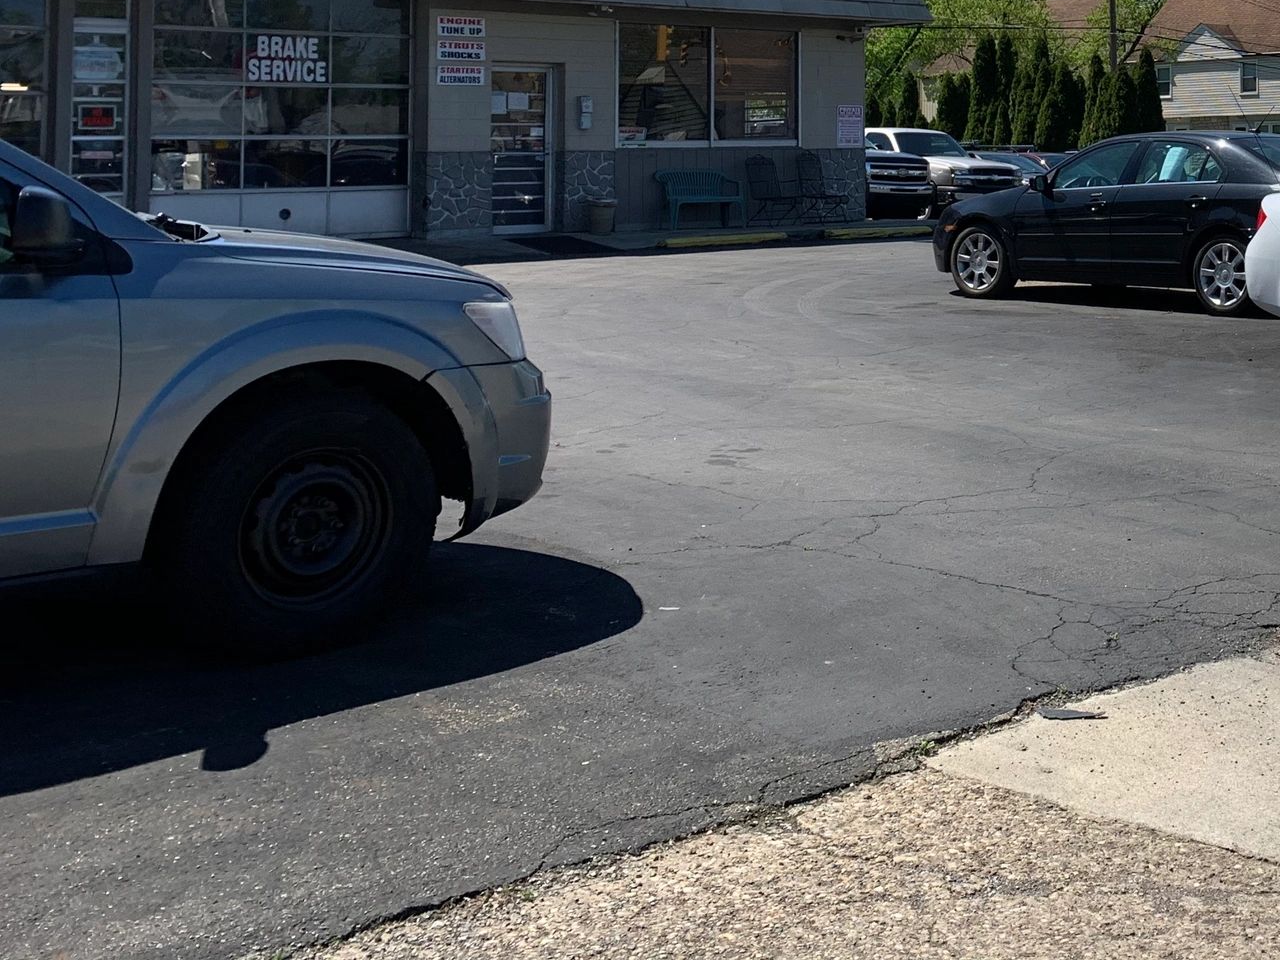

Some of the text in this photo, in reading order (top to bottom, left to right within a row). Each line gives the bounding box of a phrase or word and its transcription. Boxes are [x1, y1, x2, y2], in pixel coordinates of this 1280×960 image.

[439, 17, 484, 26] ENGINE
[441, 26, 482, 35] TUNE UP
[257, 35, 319, 59] BRAKE
[439, 41, 484, 50] STRUTS
[440, 50, 481, 59] SHOCKS
[248, 58, 327, 82] SERVICE
[439, 66, 482, 75] STARTERS
[439, 75, 481, 84] ALTERNATORS
